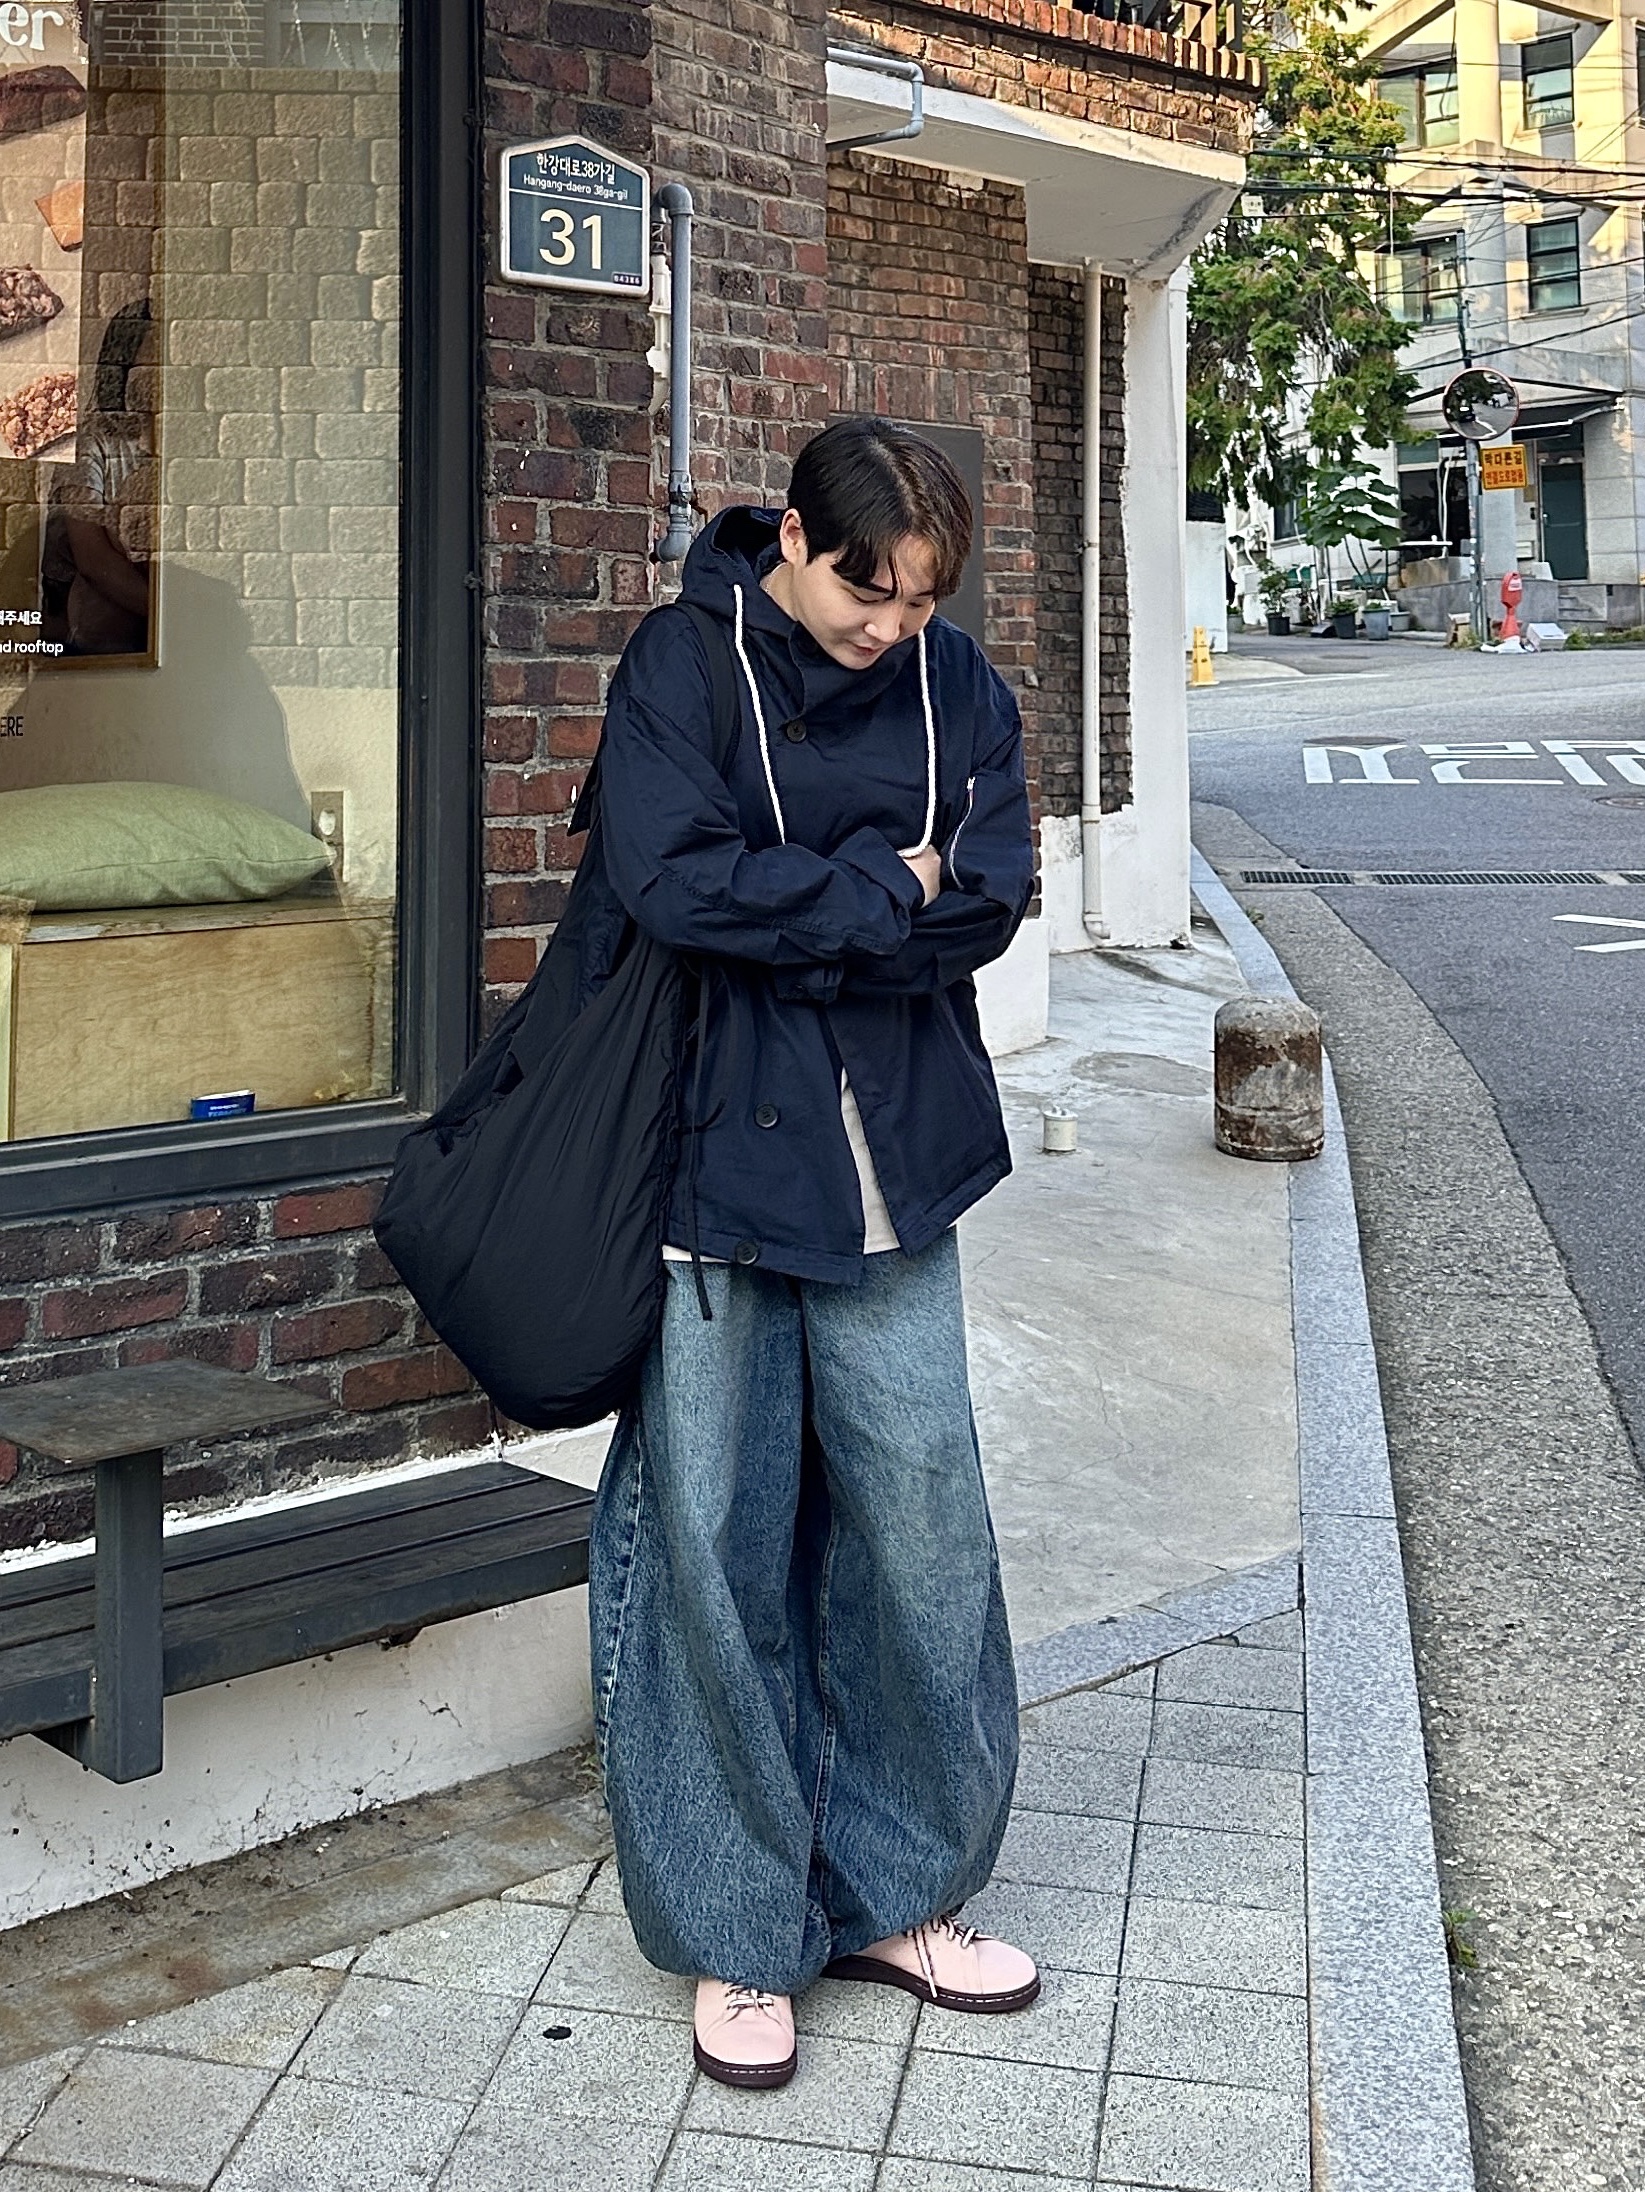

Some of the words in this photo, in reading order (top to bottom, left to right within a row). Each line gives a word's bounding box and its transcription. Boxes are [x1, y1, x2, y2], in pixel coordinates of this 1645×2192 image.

[536, 152, 615, 185] 한강대로38가길
[523, 173, 591, 194] Hangang-daero
[593, 184, 628, 200] 38ga-gil
[539, 208, 602, 270] 31
[14, 639, 64, 657] rooftop
